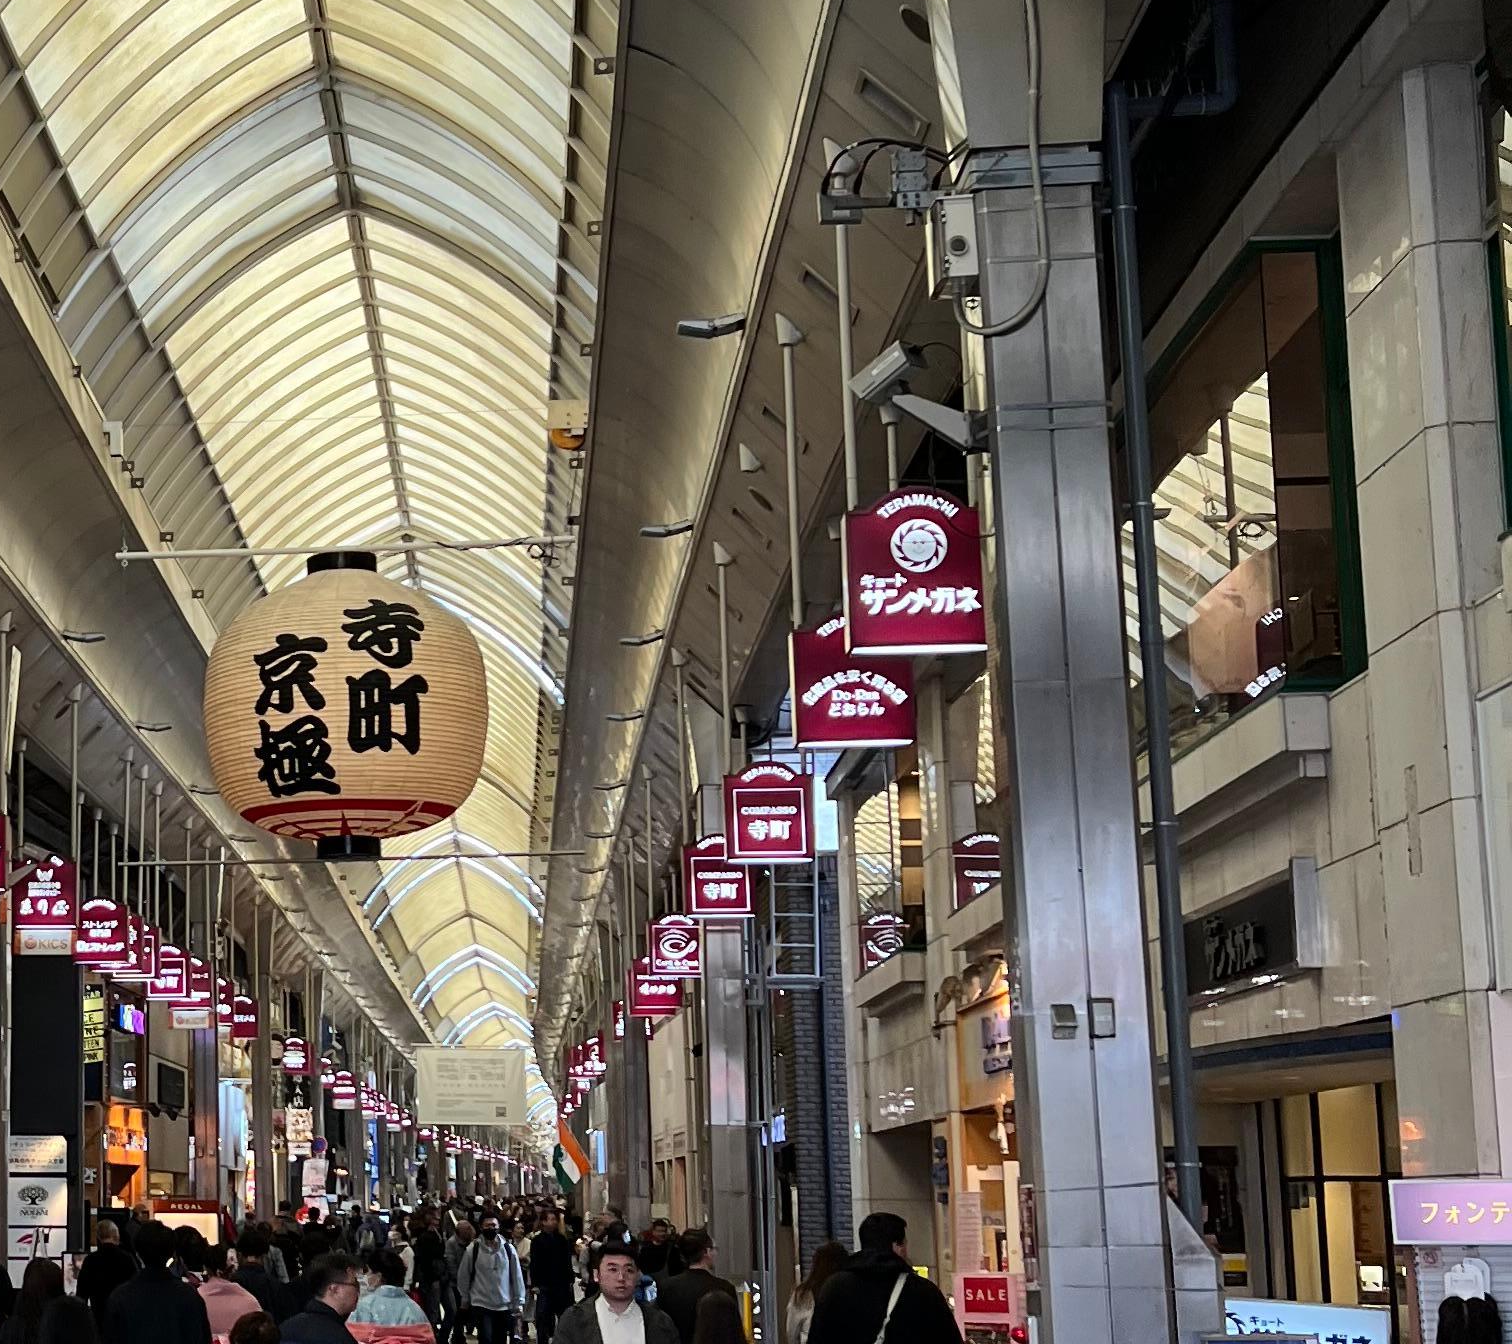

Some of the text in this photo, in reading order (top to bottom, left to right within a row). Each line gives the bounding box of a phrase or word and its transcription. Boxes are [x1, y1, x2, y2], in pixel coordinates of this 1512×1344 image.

[877, 493, 959, 519] TERAMACHI
[859, 572, 908, 589] キョート
[859, 586, 982, 616] サンメガネ
[341, 598, 429, 756] 寺町
[253, 632, 342, 798] 京極
[740, 765, 795, 783] TERAMACHI
[747, 820, 792, 840] 寺町
[702, 882, 739, 900] 寺町
[964, 1287, 1007, 1301] SALE
[1249, 1315, 1285, 1328] キョート
